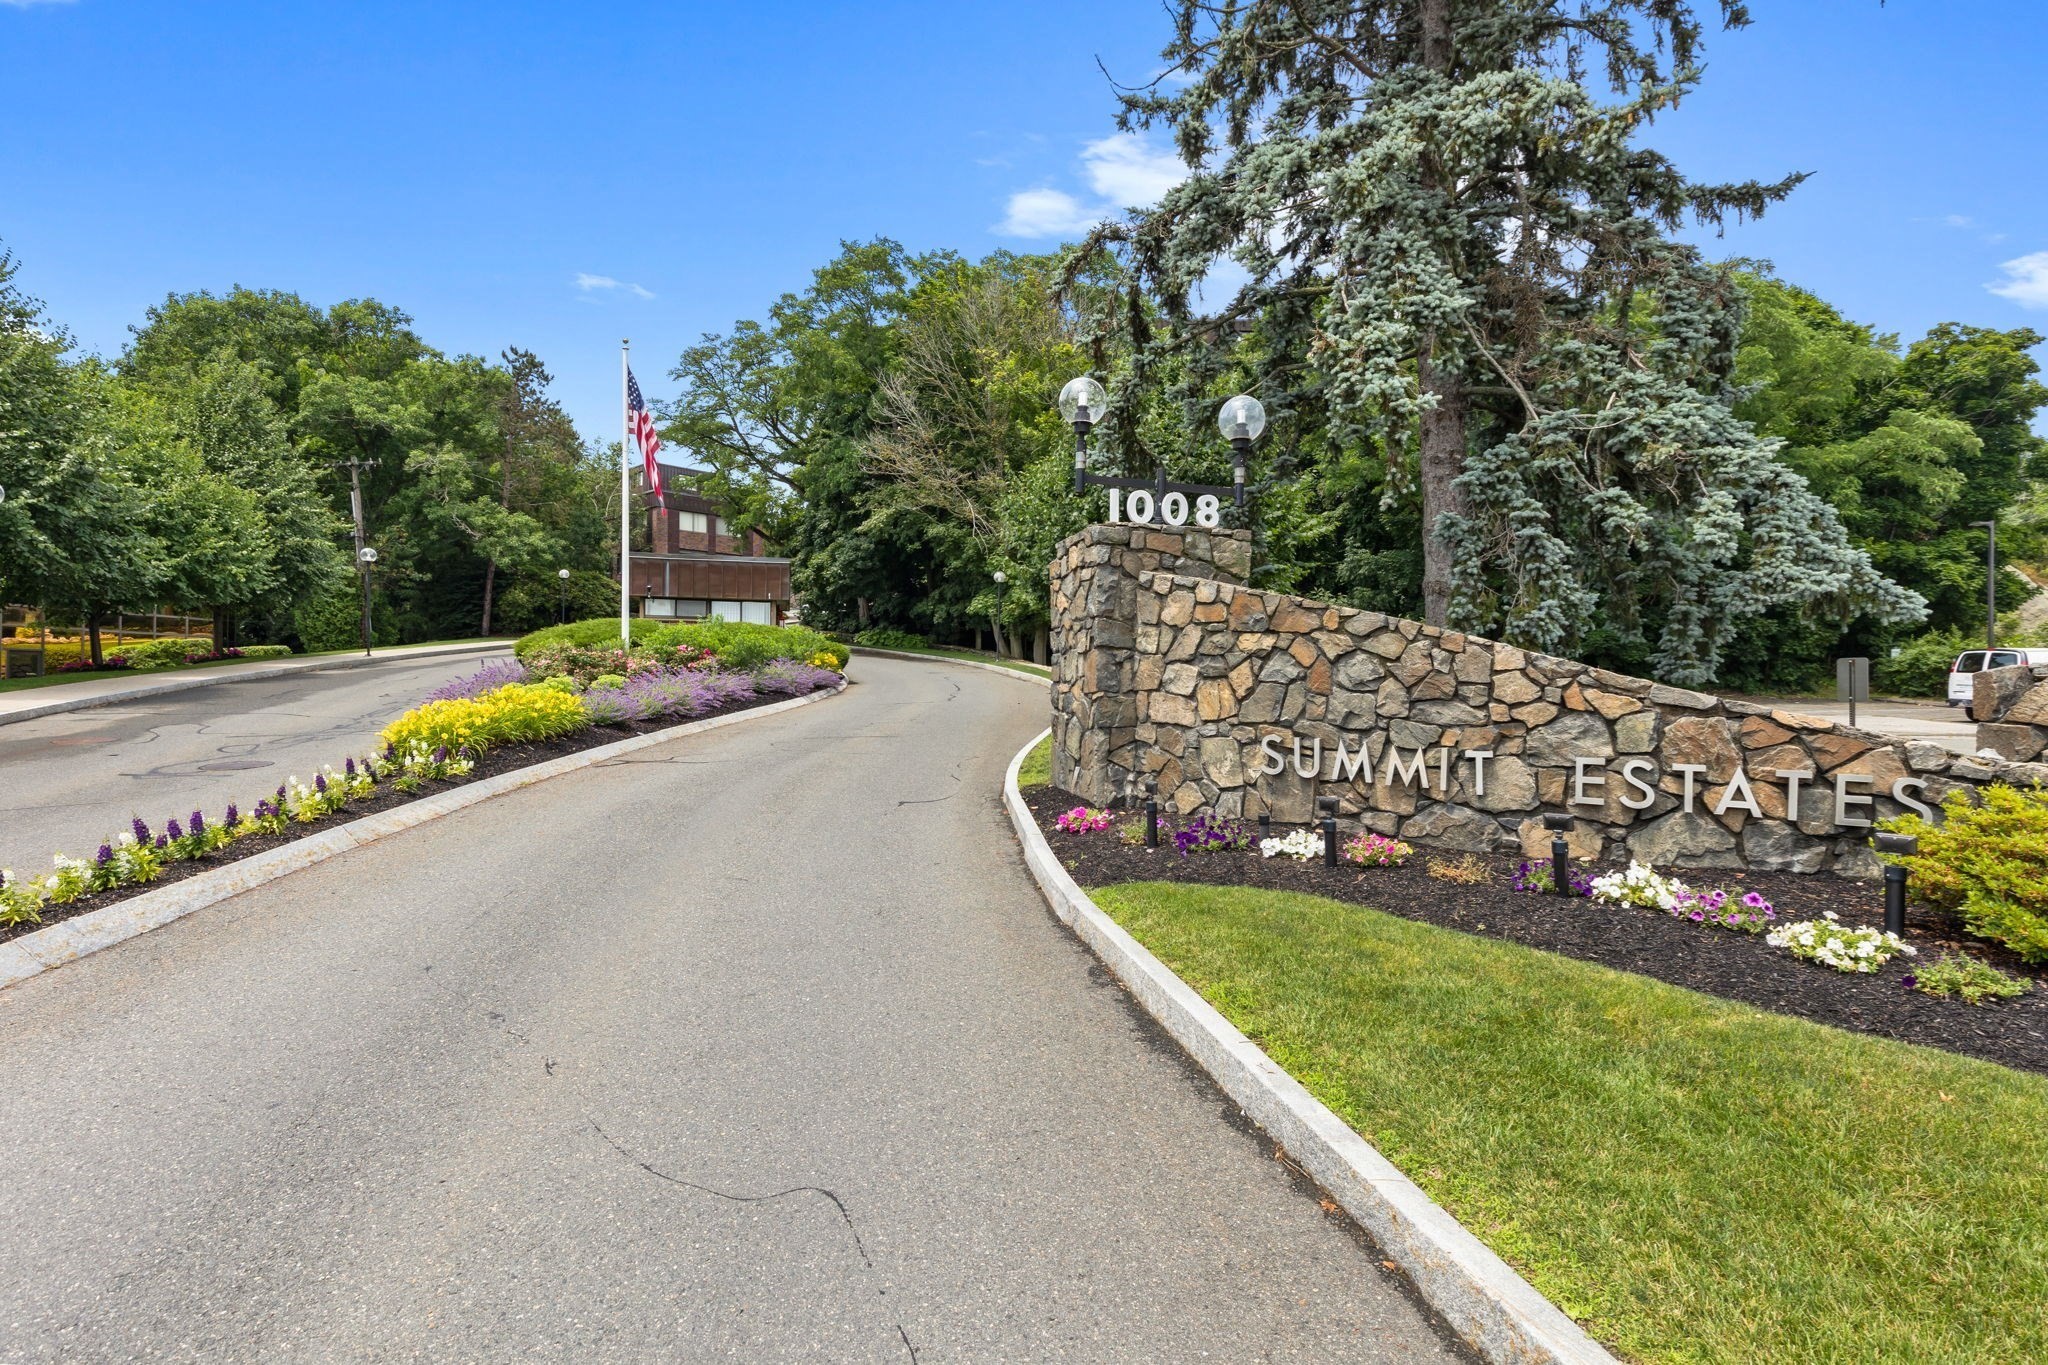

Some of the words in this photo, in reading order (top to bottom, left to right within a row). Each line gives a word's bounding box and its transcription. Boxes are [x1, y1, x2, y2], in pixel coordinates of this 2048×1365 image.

[1109, 488, 1220, 528] 1008
[1260, 734, 1494, 796] SUMMIT
[1574, 756, 1934, 829] ESTATES
